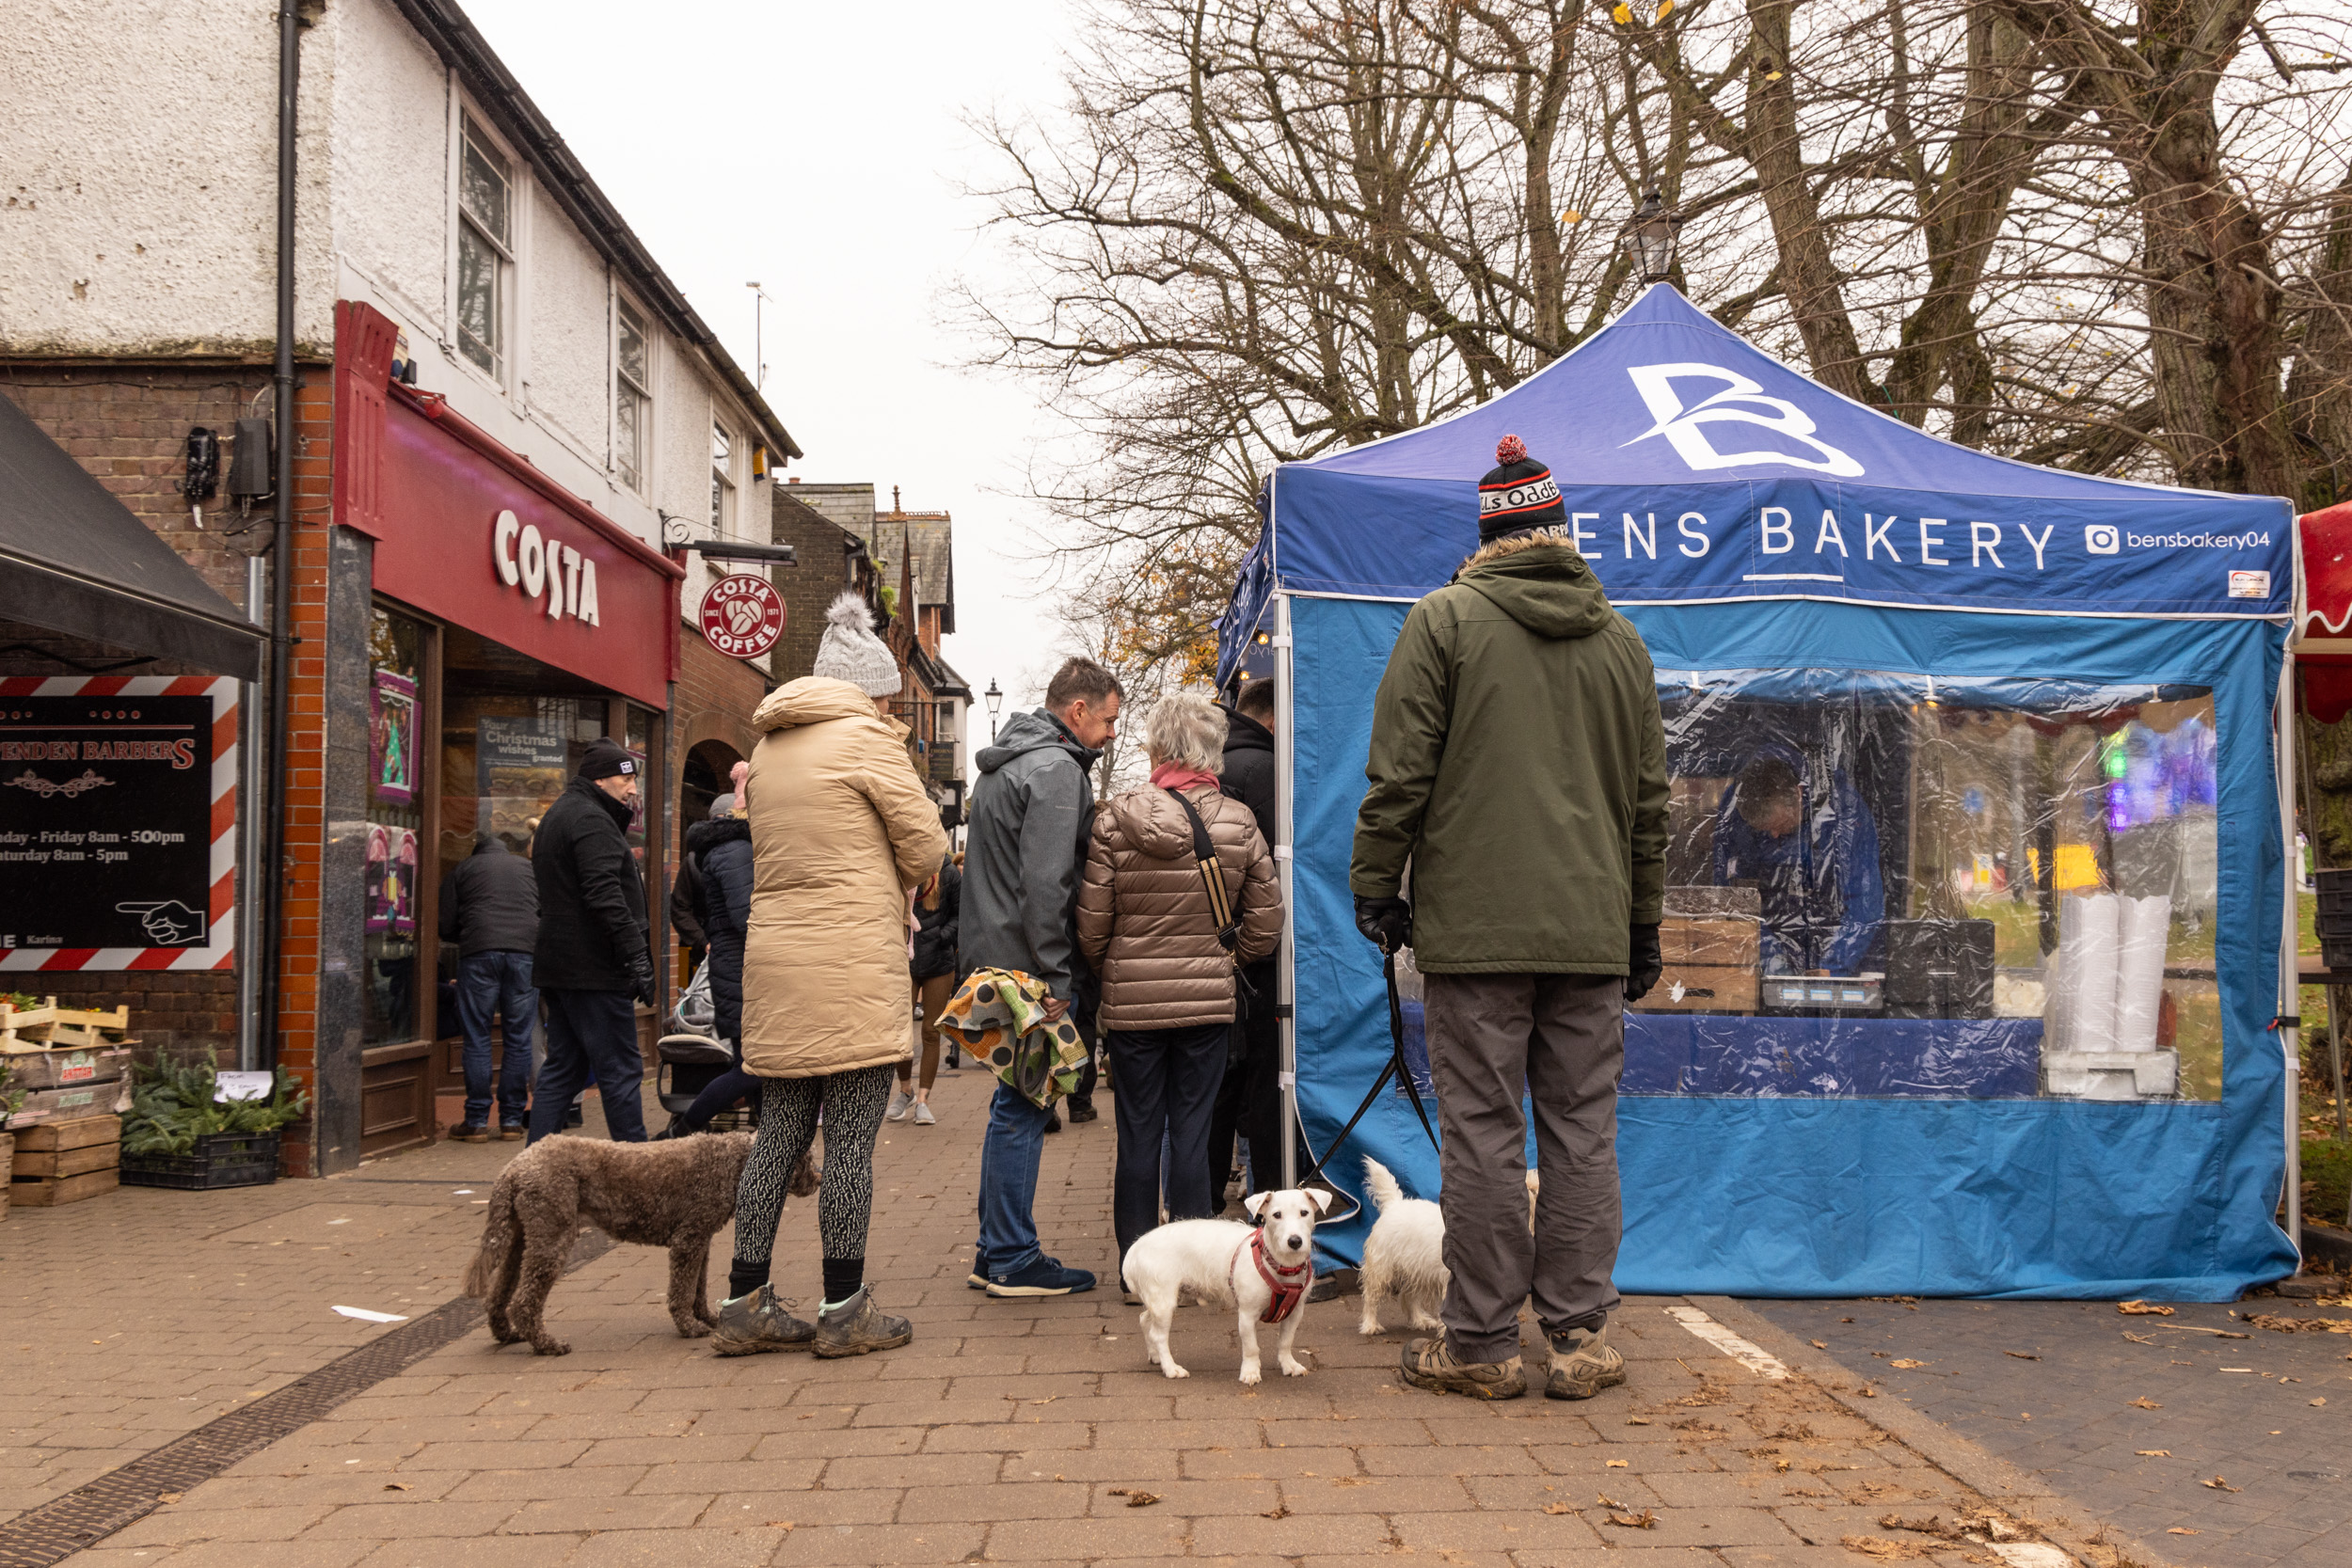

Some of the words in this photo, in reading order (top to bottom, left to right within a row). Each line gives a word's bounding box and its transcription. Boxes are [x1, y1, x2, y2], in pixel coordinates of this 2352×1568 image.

[1573, 512, 1710, 559] ENS
[1761, 507, 2055, 569] BAKERY
[2127, 531, 2271, 550] bensbakery04
[495, 510, 599, 627] COSTA
[712, 578, 770, 603] COSTA
[767, 608, 779, 616] 1971
[709, 624, 777, 652] COFFEE
[485, 730, 557, 747] Christmas
[0, 741, 78, 760] ENDEN
[82, 738, 195, 769] BARBERS
[498, 744, 537, 755] wishes
[532, 754, 564, 763] granted
[40, 831, 86, 846] Friday
[87, 831, 119, 843] 8am
[53, 849, 86, 861] 8am
[96, 849, 129, 863] 5pm
[26, 935, 63, 943] Karina
